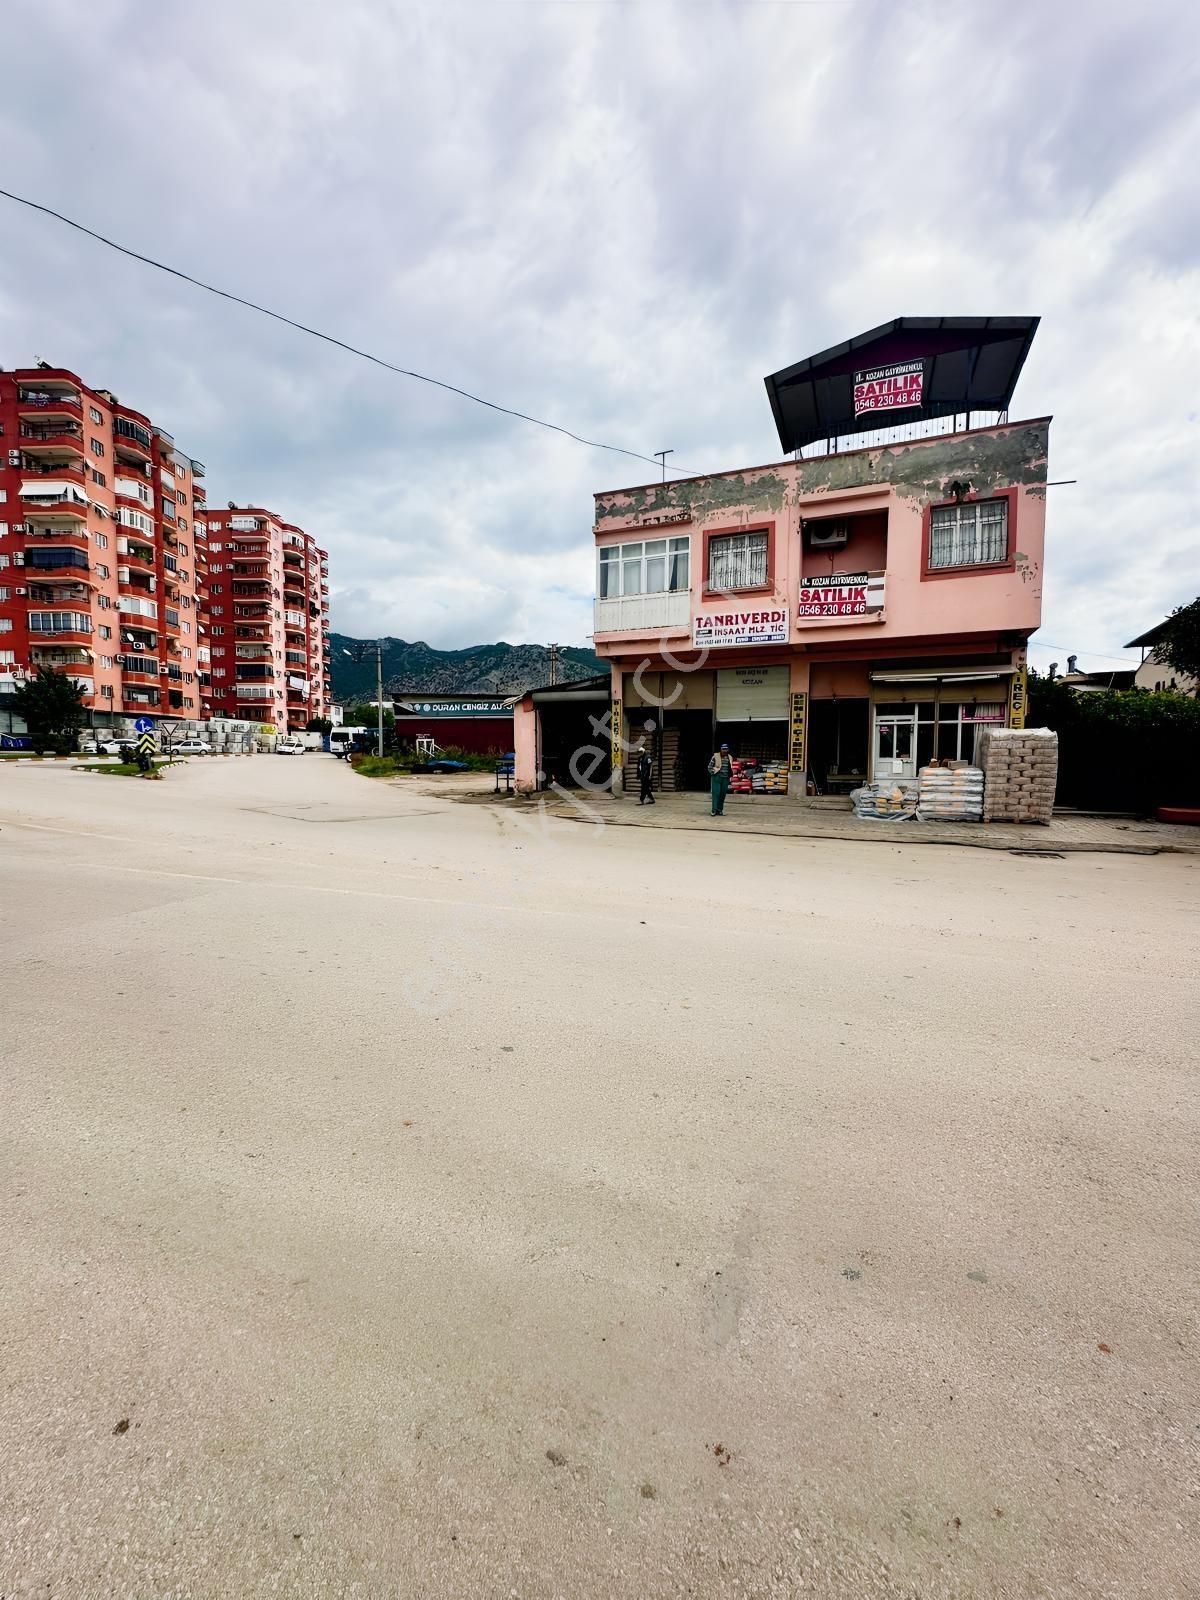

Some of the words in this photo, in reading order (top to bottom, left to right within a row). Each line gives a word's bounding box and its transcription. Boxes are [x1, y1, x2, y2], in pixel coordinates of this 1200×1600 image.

[866, 369, 885, 381] KOZAN
[855, 374, 923, 398] SATILIK
[855, 398, 875, 411] 0546
[878, 395, 894, 407] 230
[897, 393, 907, 403] 48
[910, 391, 921, 401] 46
[800, 586, 867, 602] SATILIK
[800, 605, 820, 615] 0546
[822, 604, 838, 615] 230
[841, 603, 852, 614] 48
[854, 603, 865, 613] 46
[432, 703, 460, 711] DURAN
